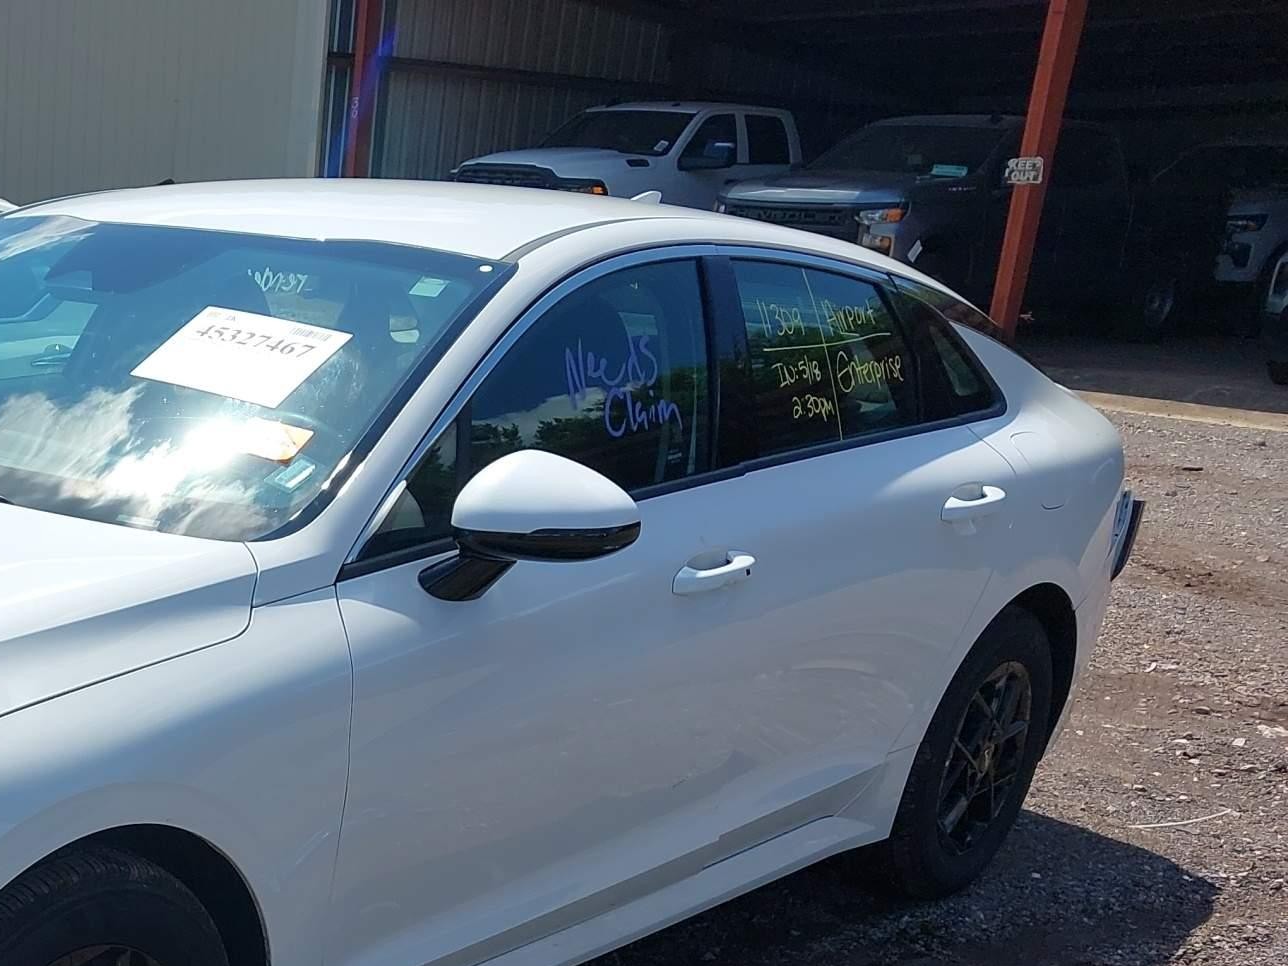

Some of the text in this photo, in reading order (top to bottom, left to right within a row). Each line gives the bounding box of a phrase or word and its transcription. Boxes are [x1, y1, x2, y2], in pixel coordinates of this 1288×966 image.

[1008, 158, 1041, 170] KEEP
[1011, 170, 1037, 181] OUT
[756, 298, 806, 337] 11309
[820, 298, 876, 337] Airport
[195, 324, 317, 358] 45327467
[836, 350, 905, 393] Enterprise
[605, 386, 683, 437] Claim
